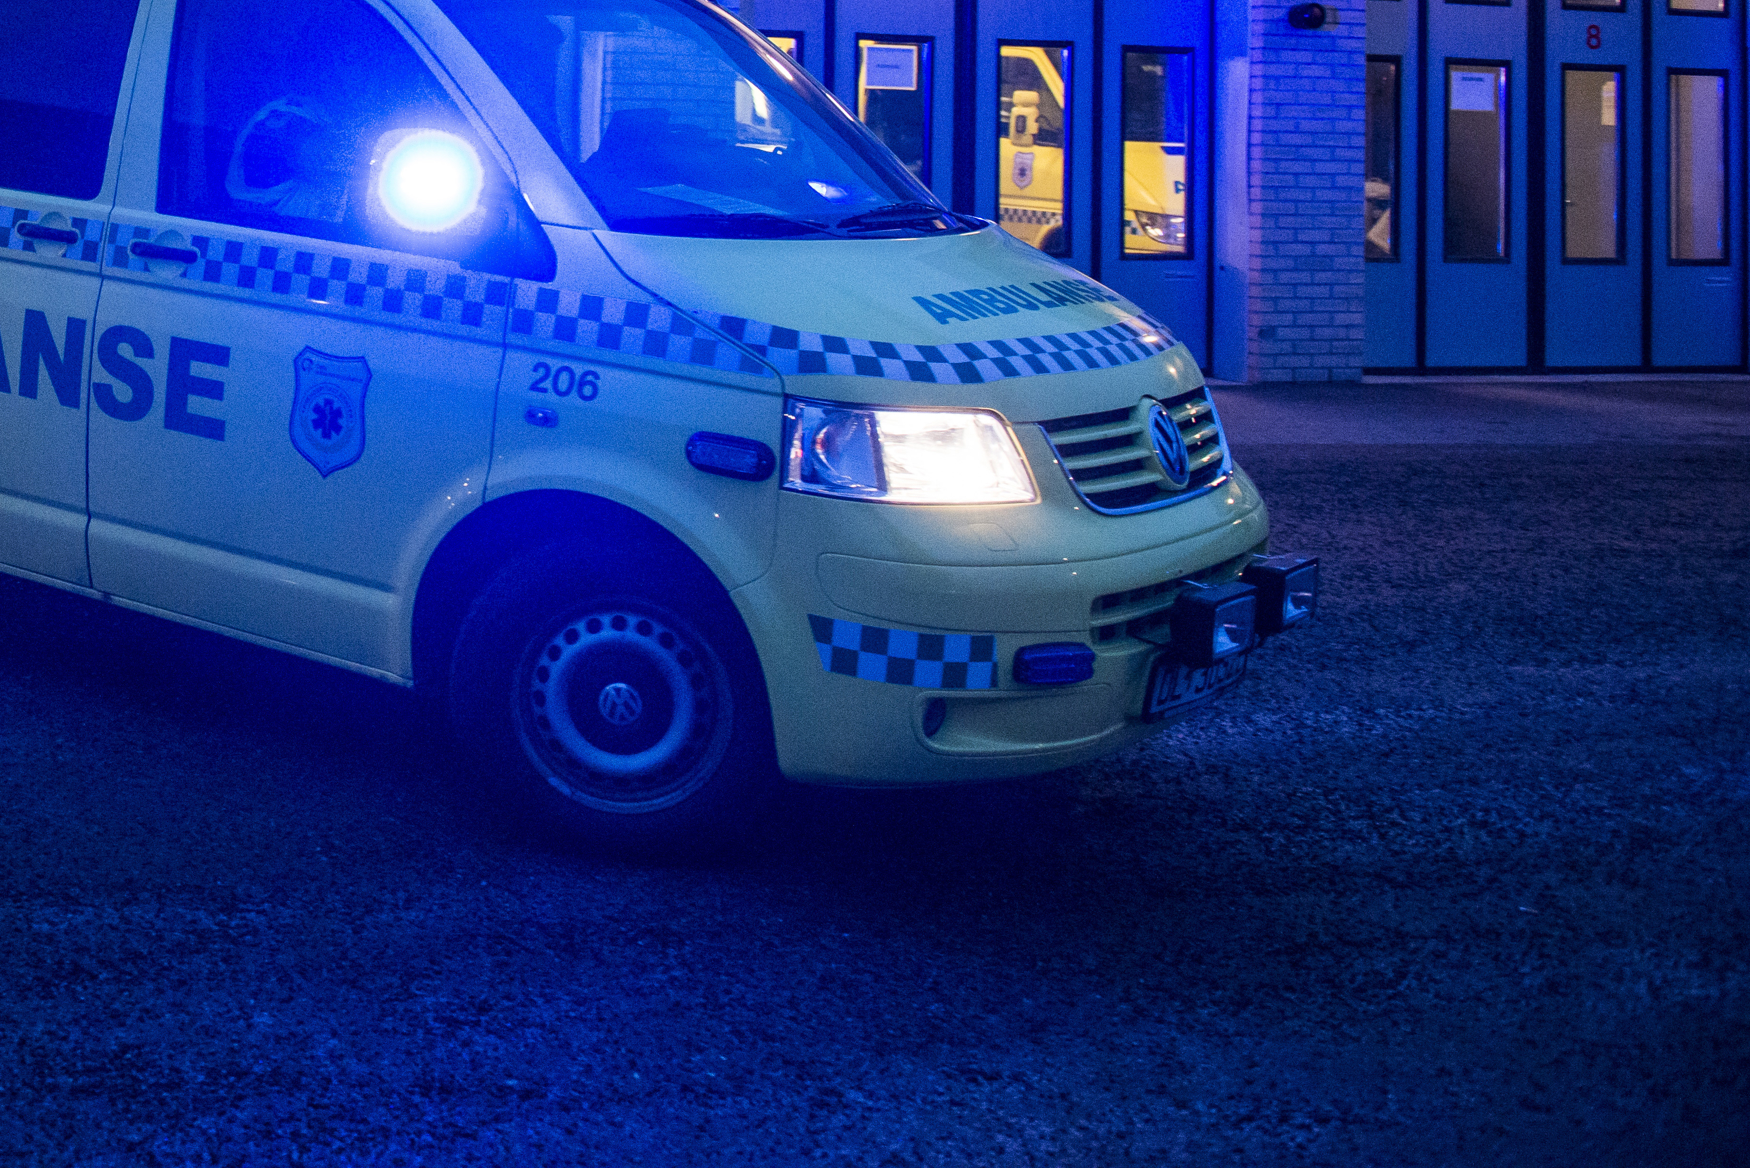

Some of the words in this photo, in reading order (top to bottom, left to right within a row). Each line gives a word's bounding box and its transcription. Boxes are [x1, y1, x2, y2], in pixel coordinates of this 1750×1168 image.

[1586, 24, 1601, 50] 8
[911, 279, 1120, 325] AMBULANSE
[528, 361, 602, 402] 206
